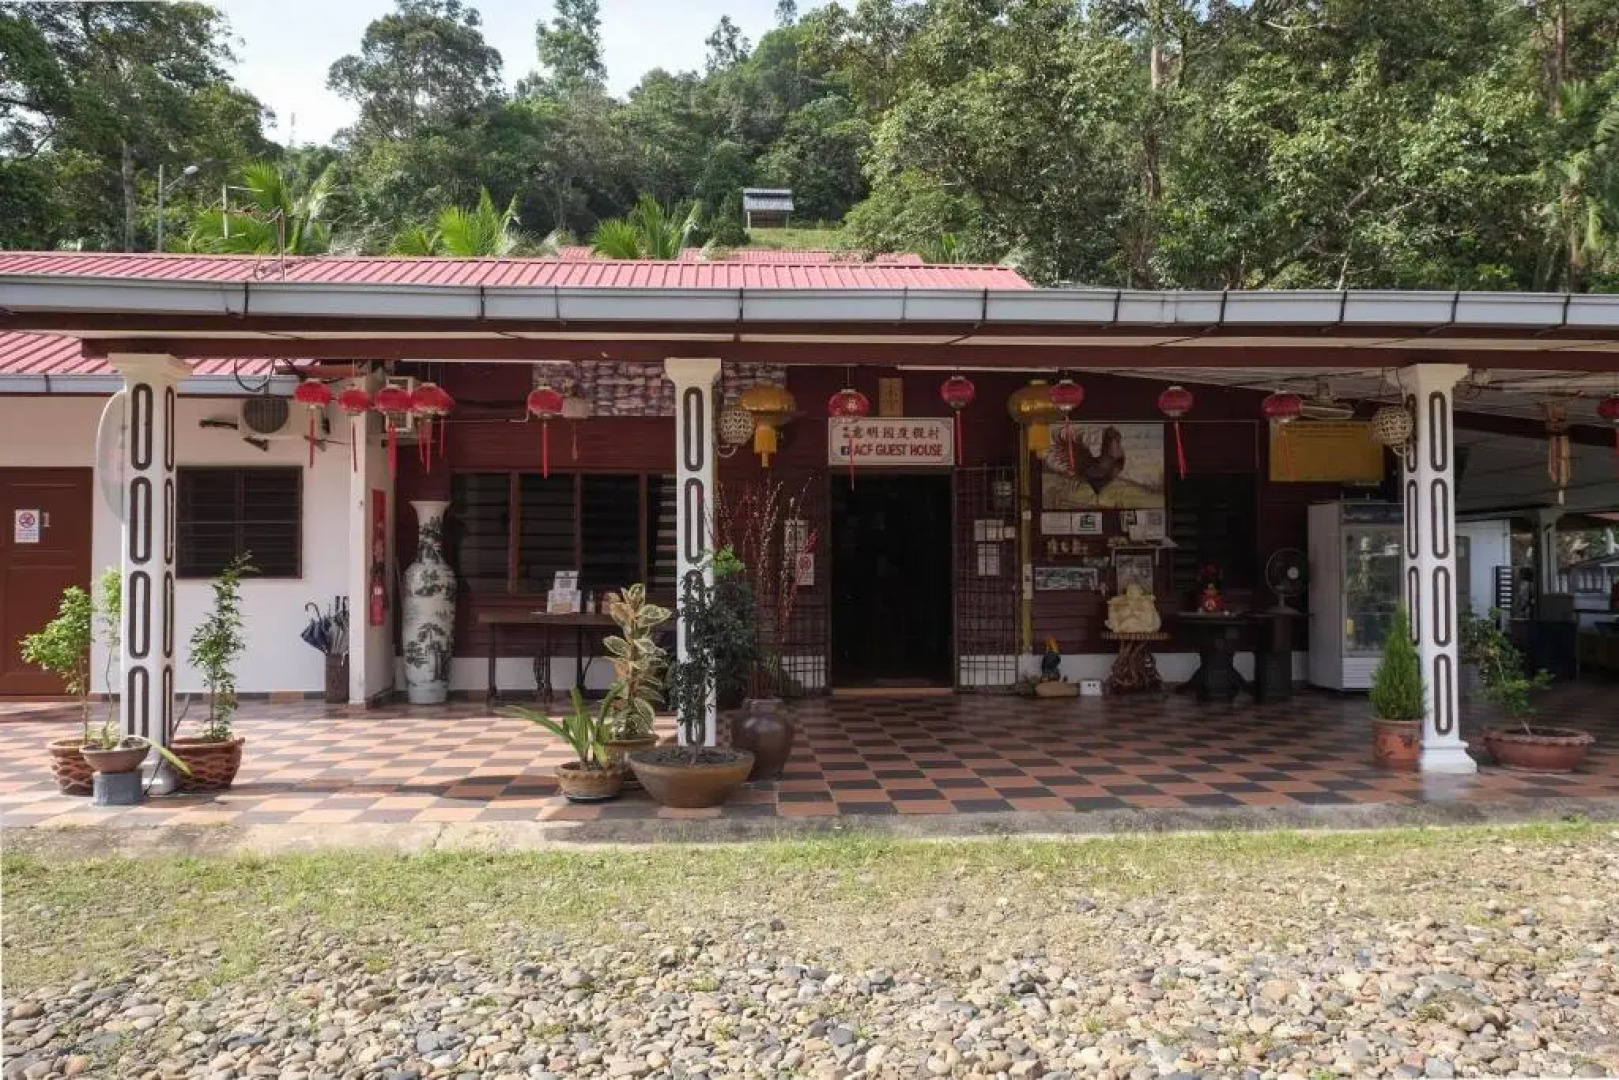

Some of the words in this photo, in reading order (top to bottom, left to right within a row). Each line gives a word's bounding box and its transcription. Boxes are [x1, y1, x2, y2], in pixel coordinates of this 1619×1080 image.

[854, 444, 873, 456] ACF
[876, 444, 906, 456] GUEST
[910, 444, 943, 456] HOUSE
